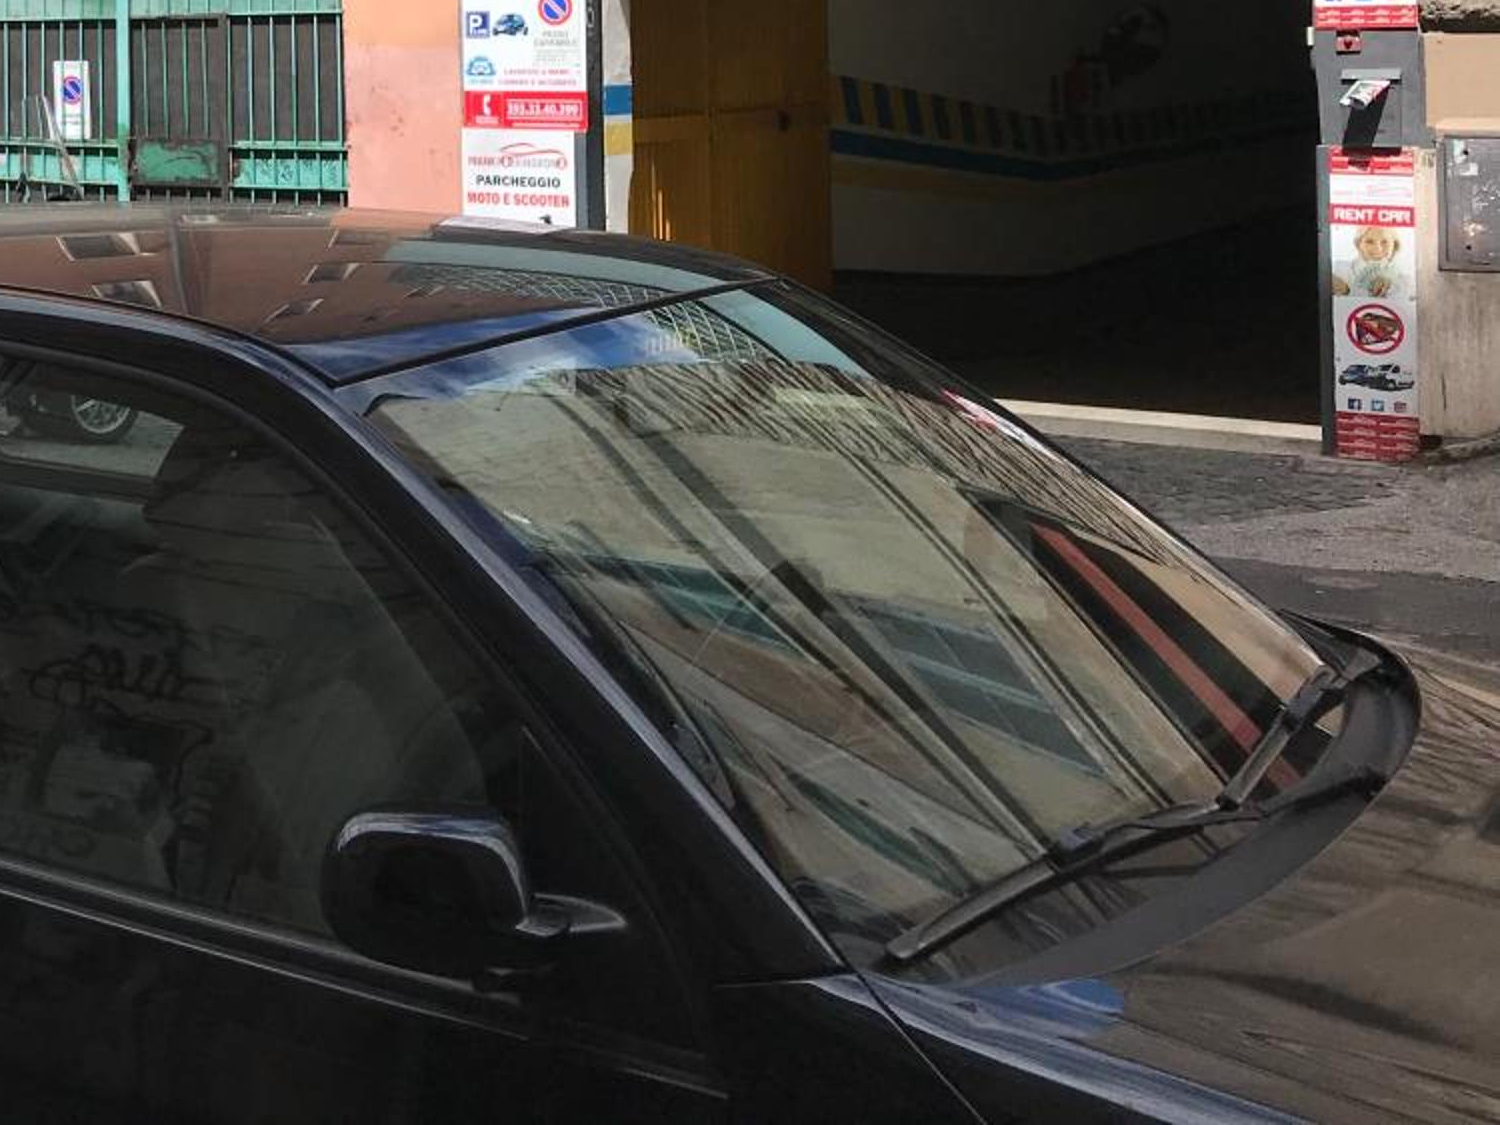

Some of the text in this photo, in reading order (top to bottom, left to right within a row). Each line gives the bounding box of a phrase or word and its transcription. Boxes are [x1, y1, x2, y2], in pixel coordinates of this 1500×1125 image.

[476, 174, 561, 188] PARCHEGGIO
[467, 192, 569, 207] MOTO E SCOOTER
[1333, 208, 1411, 223] RENT CAR
